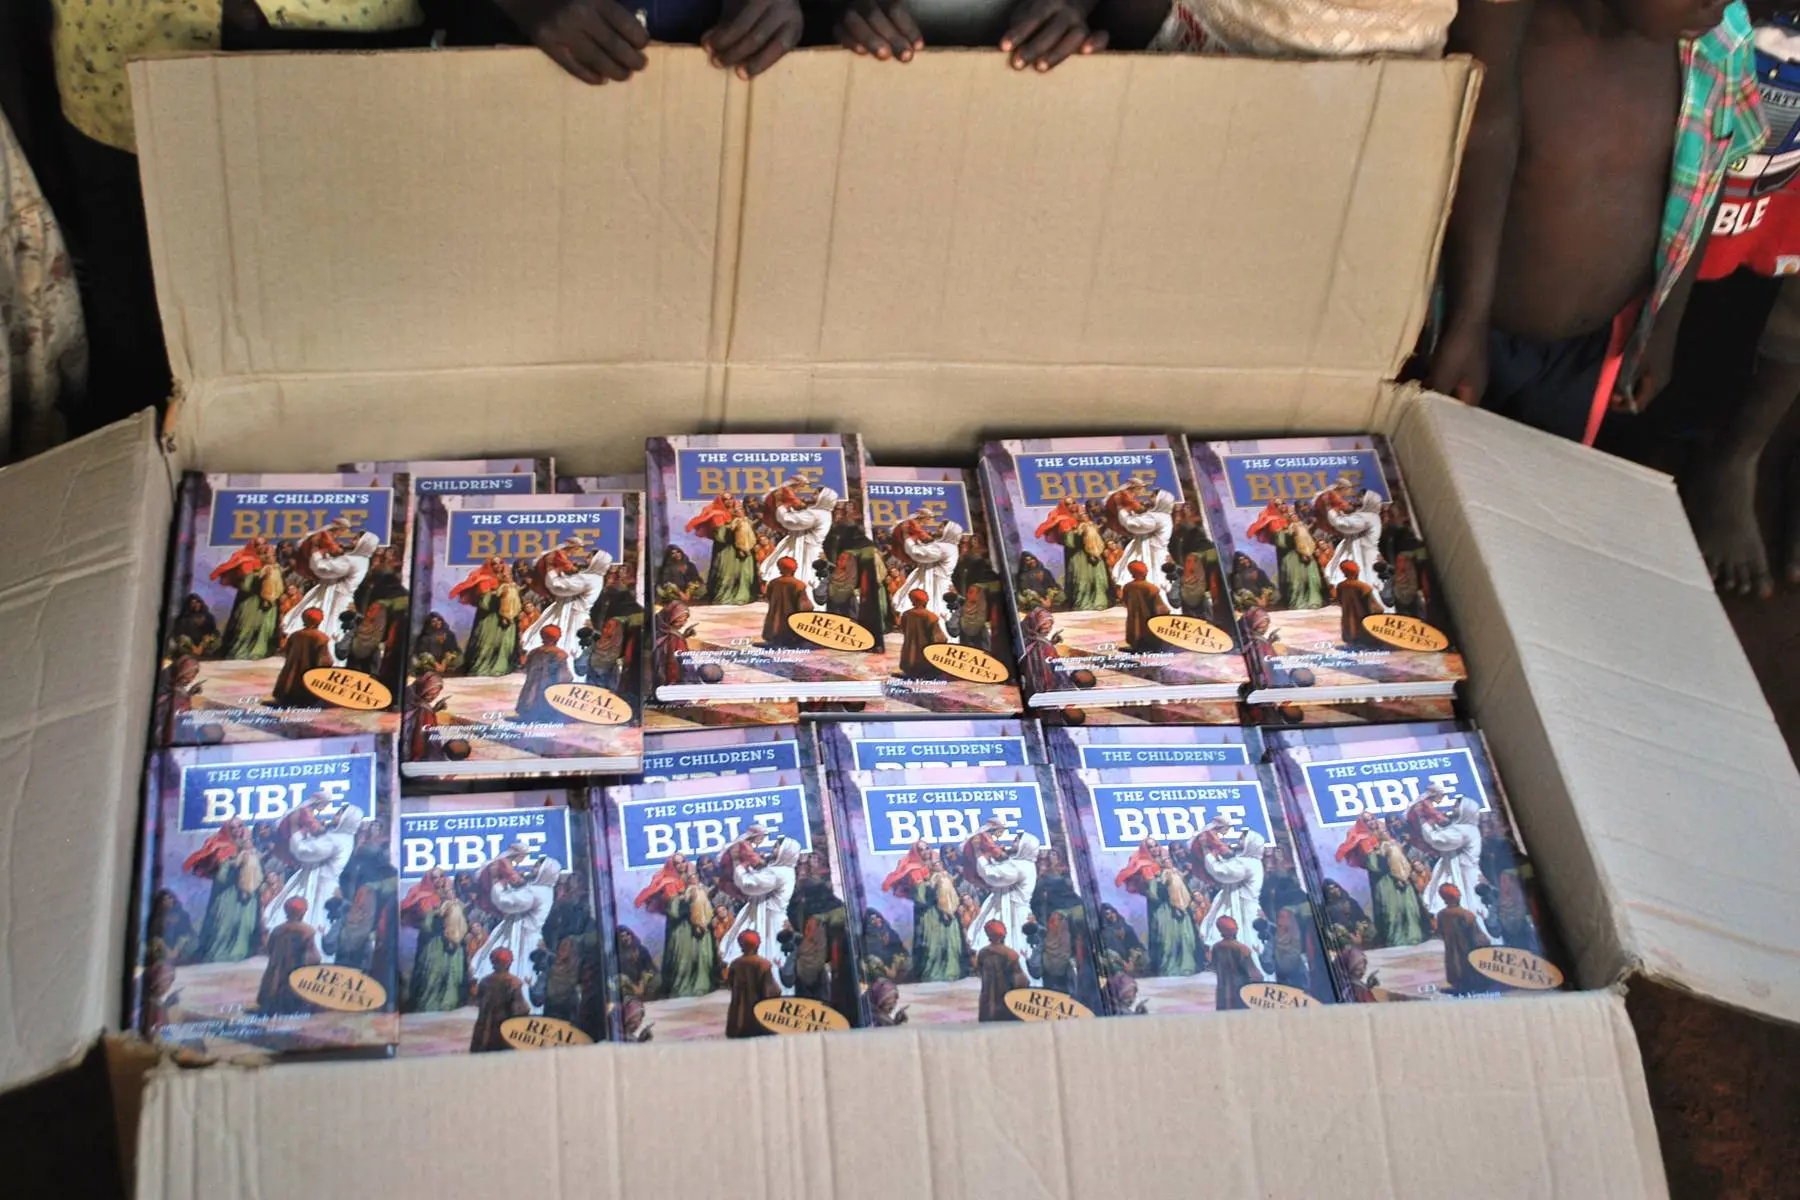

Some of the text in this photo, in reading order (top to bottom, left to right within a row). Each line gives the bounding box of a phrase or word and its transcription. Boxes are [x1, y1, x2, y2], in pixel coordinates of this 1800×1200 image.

[698, 453, 822, 462] THE CHILDREN'S
[1034, 455, 1154, 467] THE CHILDREN'S
[1242, 456, 1360, 468] THE CHILDREN'S
[420, 479, 513, 491] CHILDREN'S
[869, 485, 945, 495] HILDREN'S
[236, 494, 371, 504] THE CHILDREN'S
[471, 514, 602, 524] THE CHILDREN'S
[871, 500, 948, 526] BLE
[796, 622, 866, 648] BIBLE TEXT
[811, 614, 857, 637] REAL
[1170, 618, 1214, 639] REAL
[1385, 617, 1429, 638] REAL
[1157, 626, 1225, 650] BIBLE TEXT
[1372, 625, 1439, 648] BIBLE TEXT
[932, 654, 1000, 680] BIBLE TEXT
[946, 646, 991, 669] REAL
[311, 679, 383, 707] BIBLE TEXT
[327, 670, 376, 695] REAL
[552, 695, 623, 721] BIBLE TEXT
[568, 686, 616, 710] REAL
[643, 749, 775, 769] THE CHILDREN'S
[875, 743, 1004, 756] THE CHILDREN'S
[1102, 750, 1226, 761] THE CHILDREN'S
[206, 762, 352, 782] THE CHILDREN'S
[1325, 757, 1453, 778] THE CHILDREN'S
[886, 790, 1019, 804] THE CHILDREN'S
[1113, 788, 1242, 802] THE CHILDREN'S
[644, 794, 781, 819] THE CHILDREN'S
[405, 814, 546, 832] THE CHILDREN'S
[779, 1000, 830, 1025] REAL
[1029, 991, 1078, 1017] REAL
[763, 1011, 801, 1031] BIBLE
[526, 1019, 576, 1045] REAL
